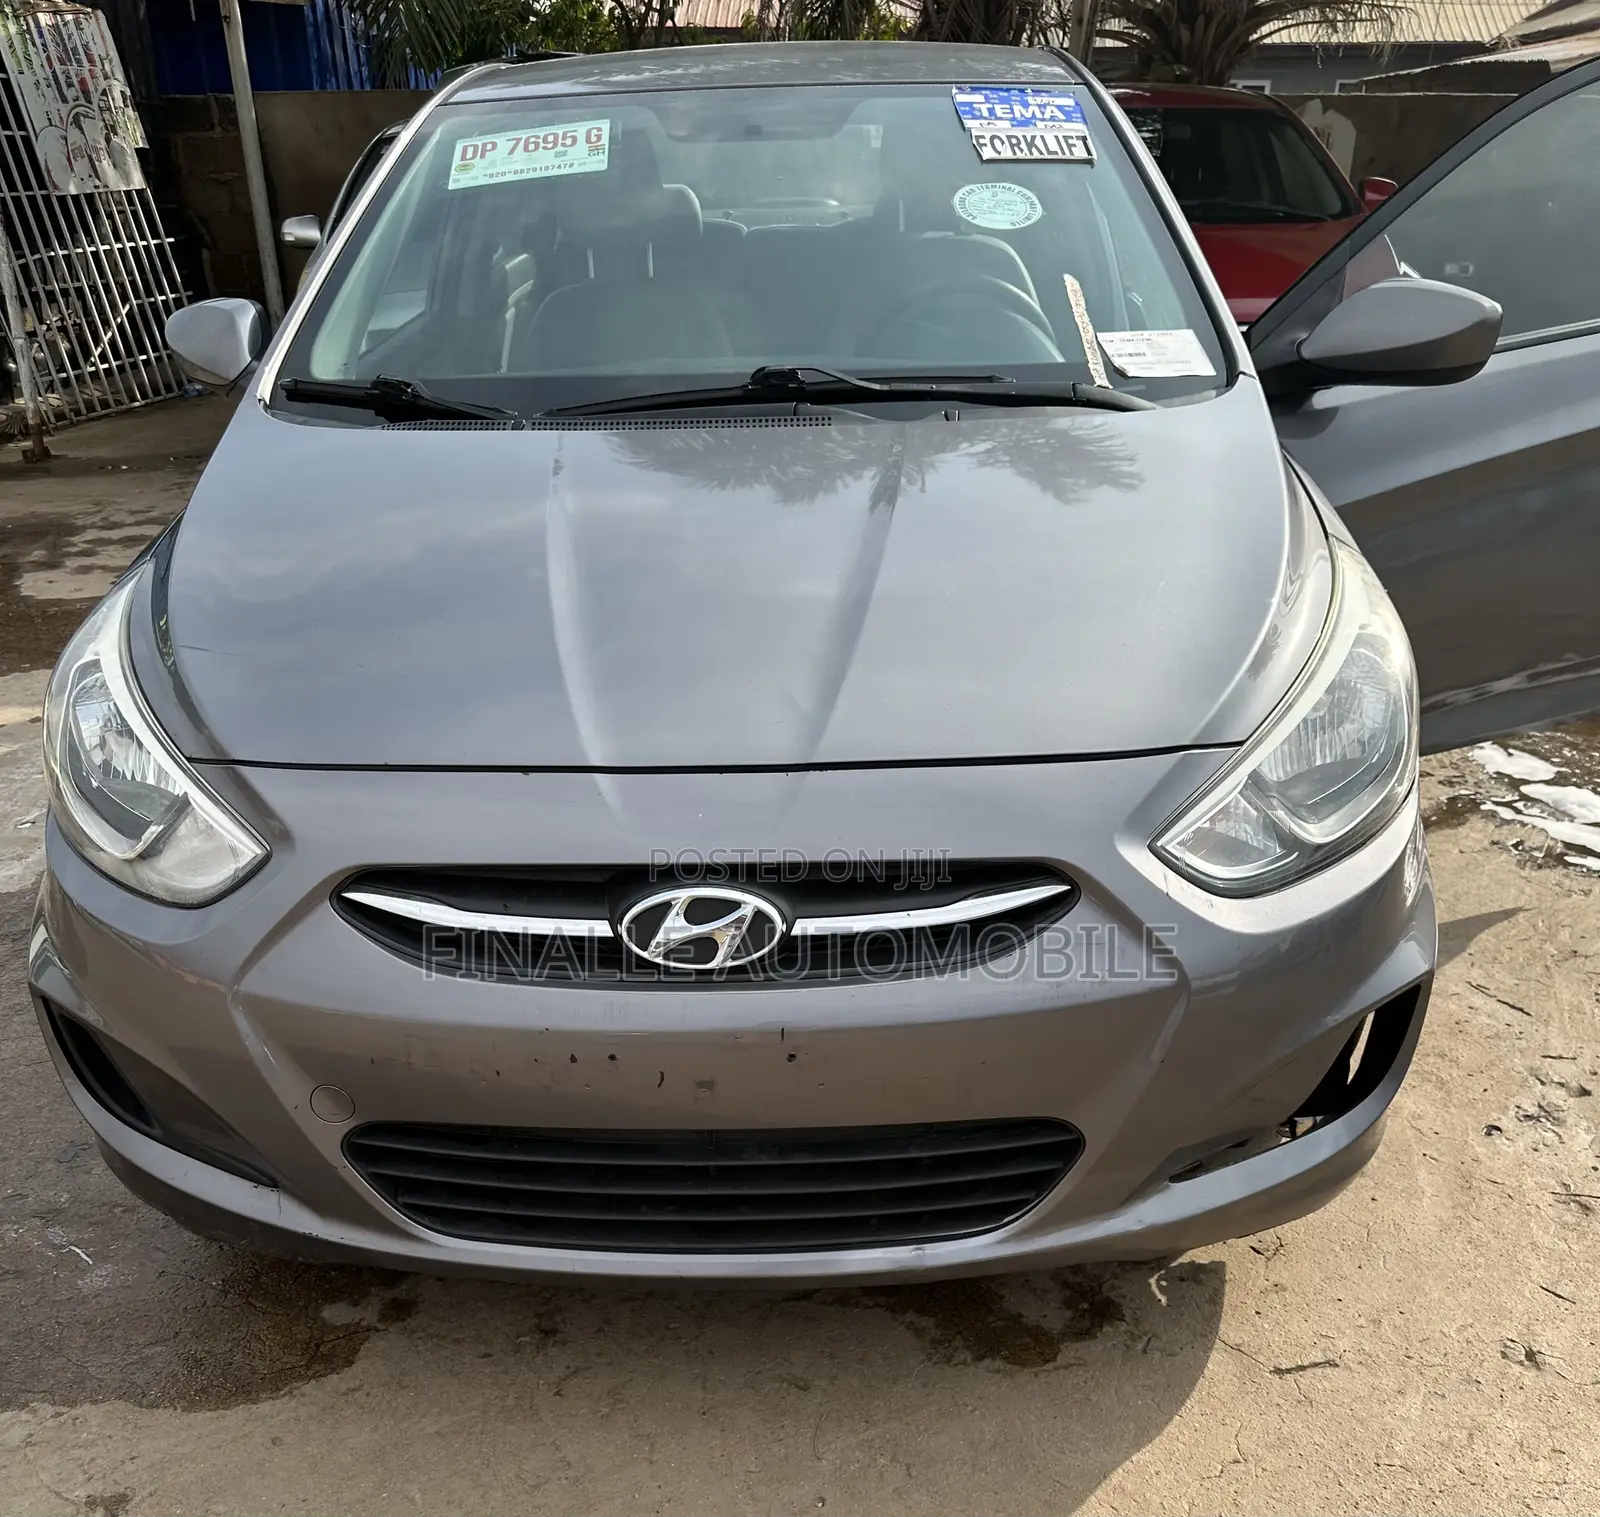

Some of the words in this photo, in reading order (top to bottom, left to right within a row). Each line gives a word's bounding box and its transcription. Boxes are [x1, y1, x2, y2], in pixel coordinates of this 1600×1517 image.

[972, 103, 1066, 120] TEMA
[460, 141, 498, 162] DP
[506, 129, 578, 157] 7695
[585, 126, 604, 145] G
[974, 134, 1093, 158] FORKLIFT
[976, 184, 1017, 193] TERMINAL
